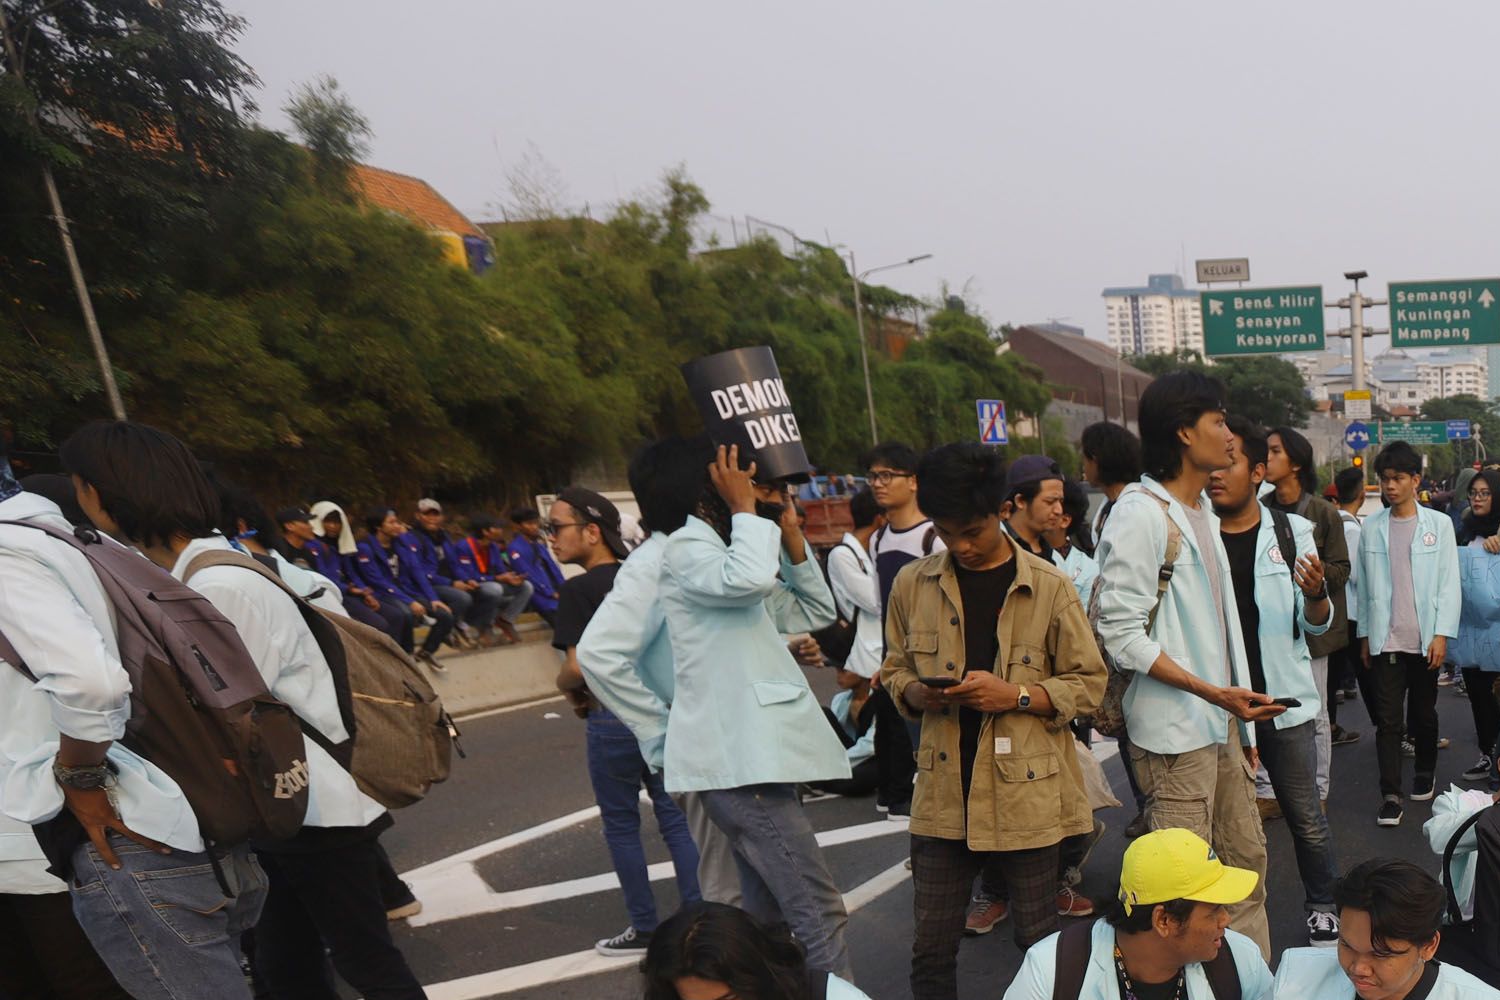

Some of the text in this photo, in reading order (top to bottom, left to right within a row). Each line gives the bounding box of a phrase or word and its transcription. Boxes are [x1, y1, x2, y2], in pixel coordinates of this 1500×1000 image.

[1203, 263, 1242, 276] KELUAR
[1279, 294, 1316, 308] Hilir
[1396, 288, 1473, 304] Semanggi
[1235, 315, 1301, 330] Senayan
[1397, 308, 1471, 323] Kuningan
[1236, 331, 1317, 349] Kebayoran
[1398, 327, 1470, 342] Mampang
